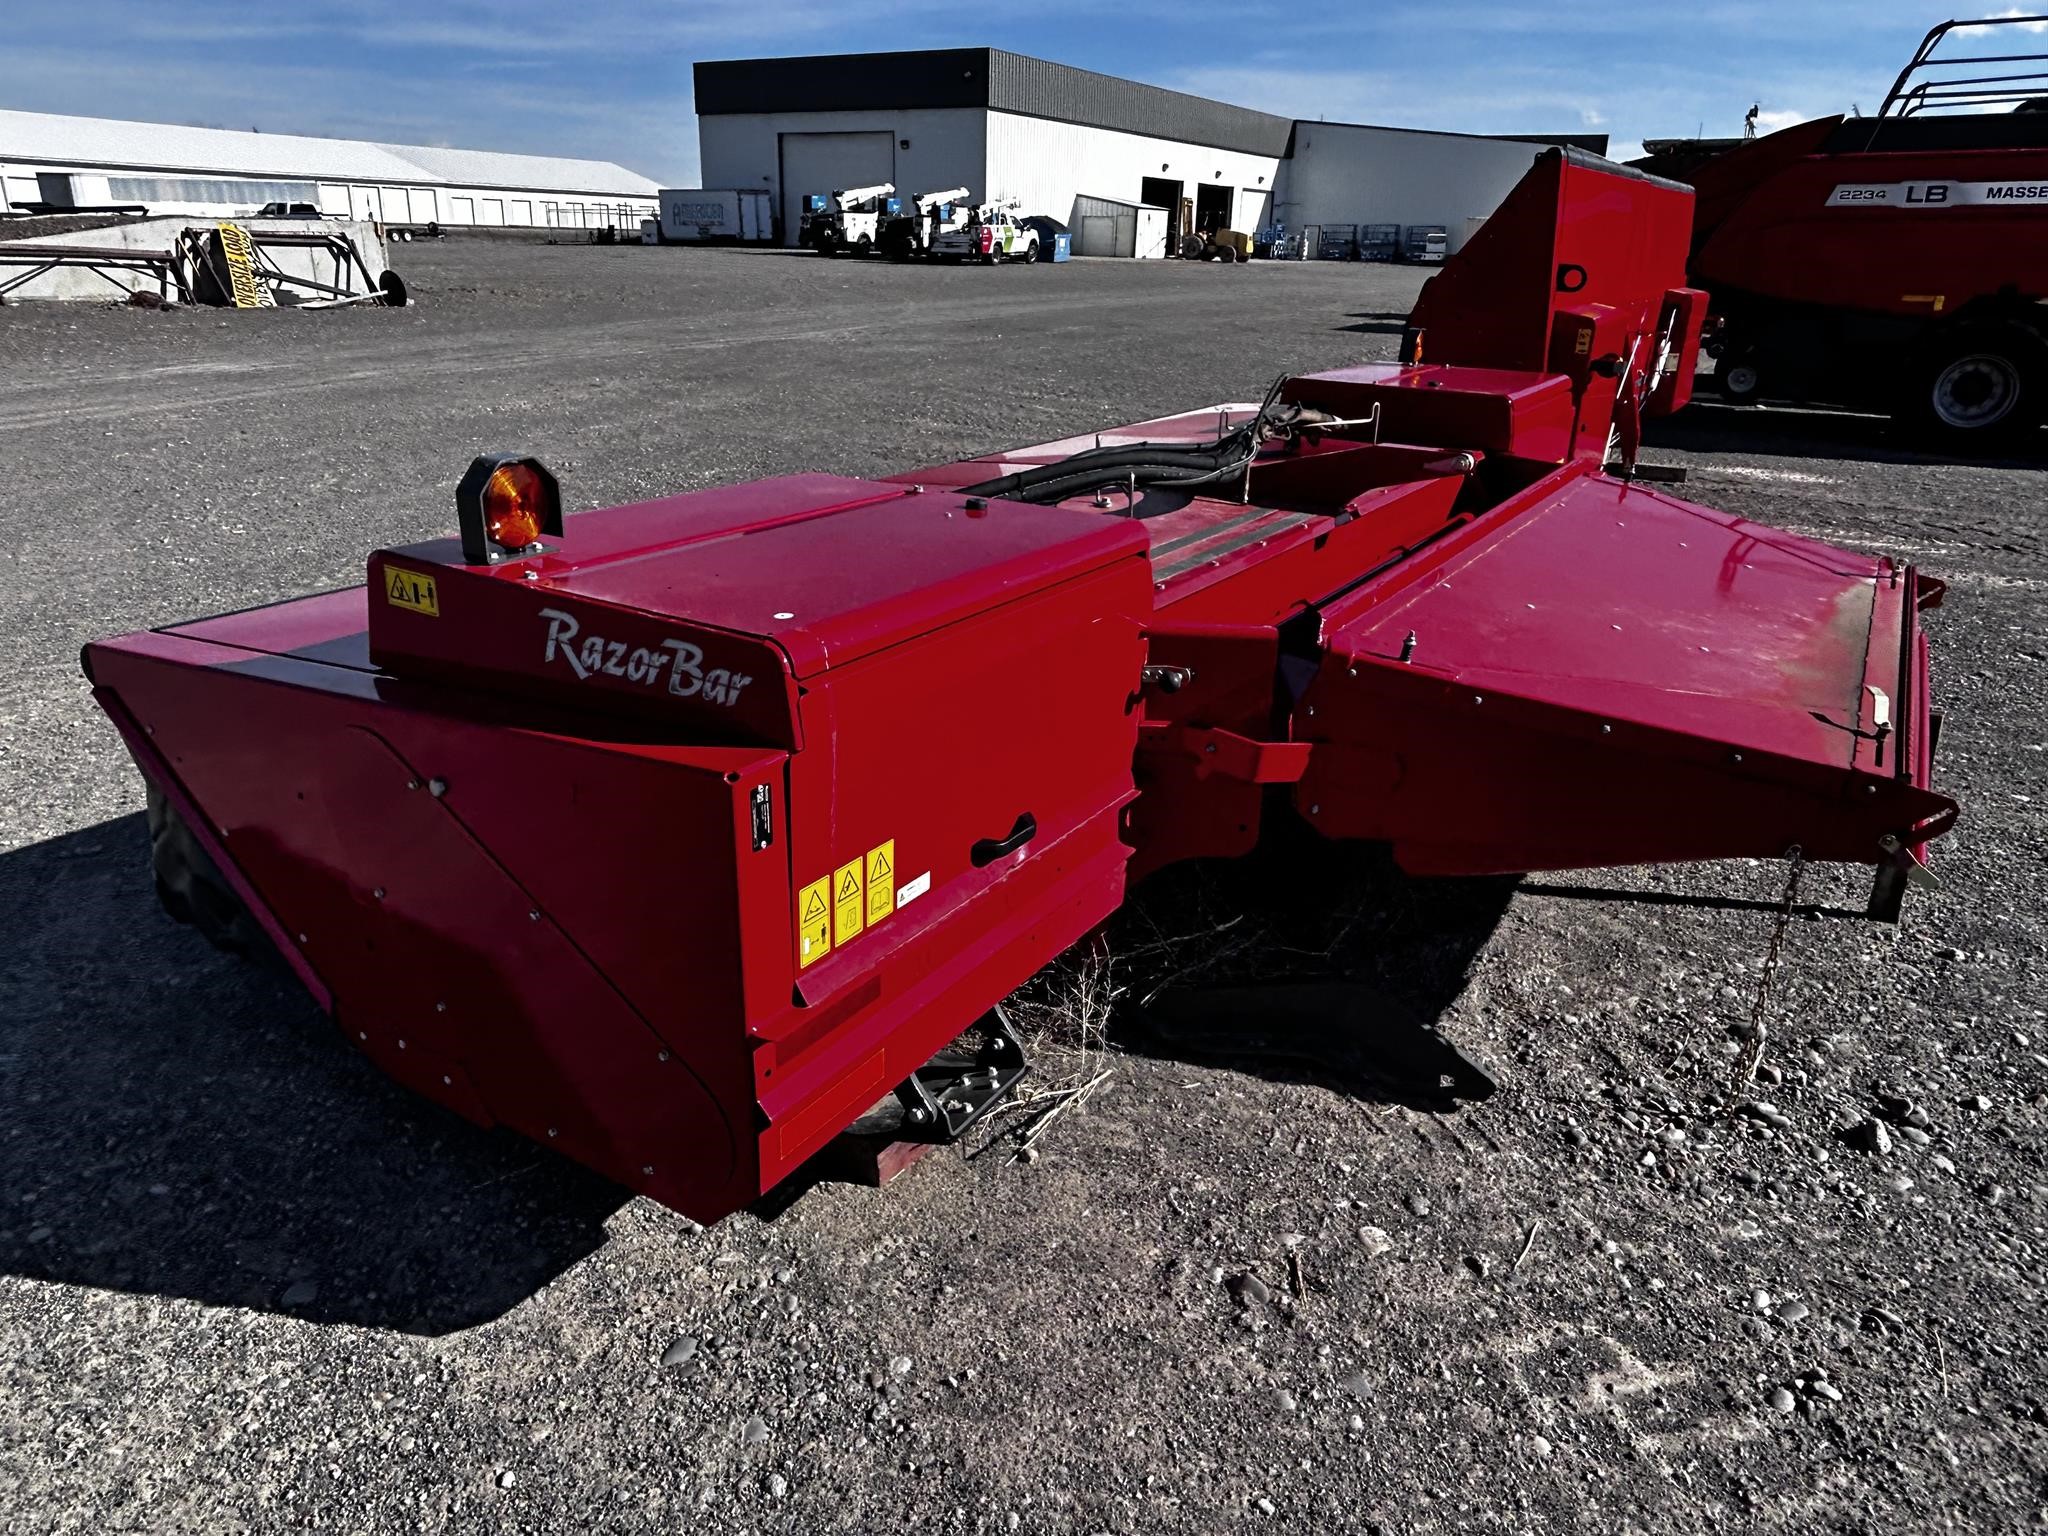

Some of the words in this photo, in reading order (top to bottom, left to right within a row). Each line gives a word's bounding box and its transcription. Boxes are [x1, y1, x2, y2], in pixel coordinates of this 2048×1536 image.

[1838, 190, 1887, 200] 2234
[1905, 185, 1949, 203] LB
[221, 228, 246, 257] LOAD
[228, 257, 256, 307] OVERSIZE
[539, 607, 753, 707] RazorBar
